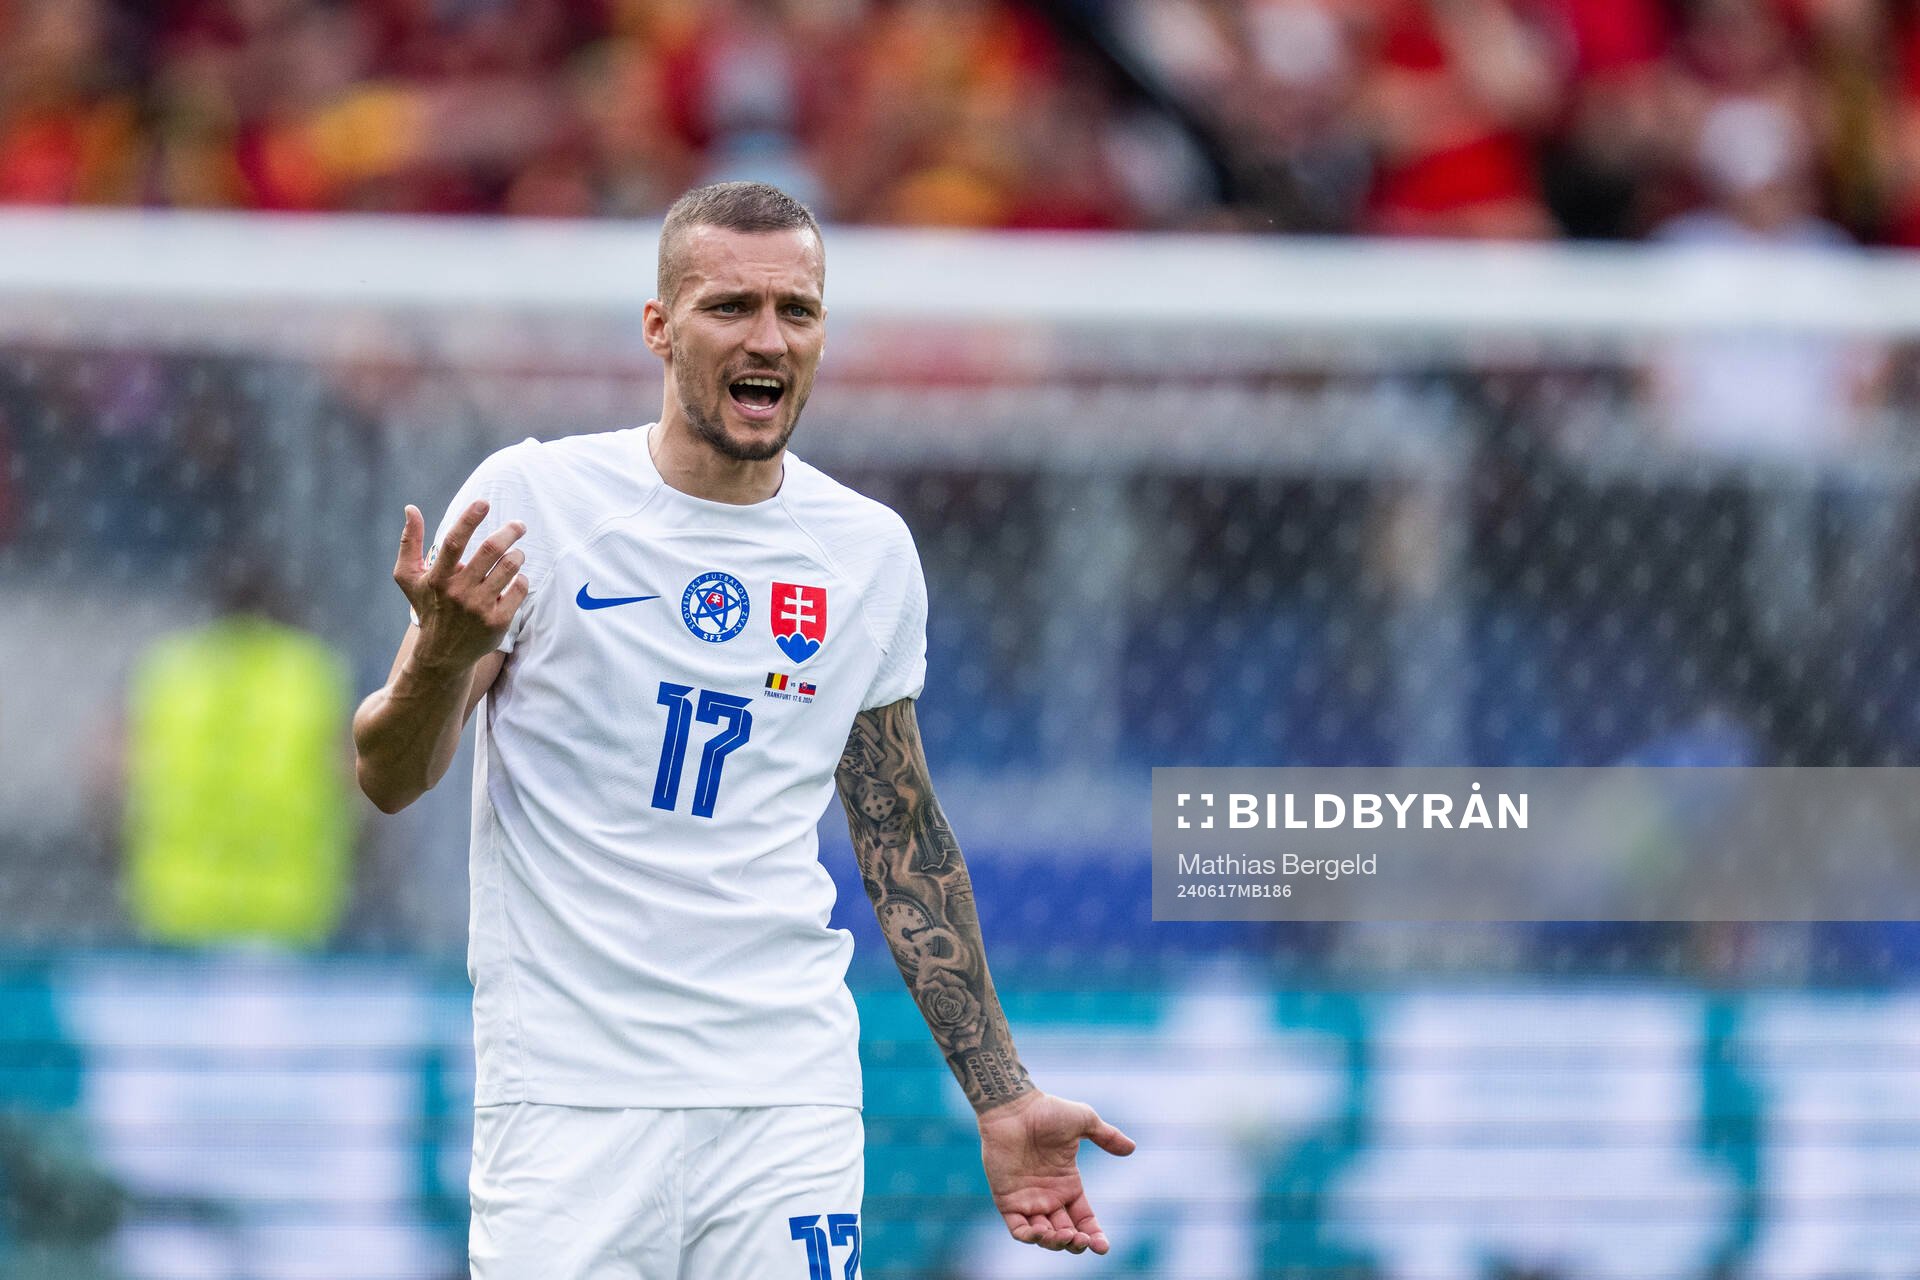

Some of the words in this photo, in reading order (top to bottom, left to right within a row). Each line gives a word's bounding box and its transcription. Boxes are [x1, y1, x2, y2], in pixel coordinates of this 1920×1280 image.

[702, 632, 722, 641] SFZ
[764, 690, 792, 701] FRANKFURT
[651, 681, 754, 818] 17
[788, 1213, 861, 1280] 17
